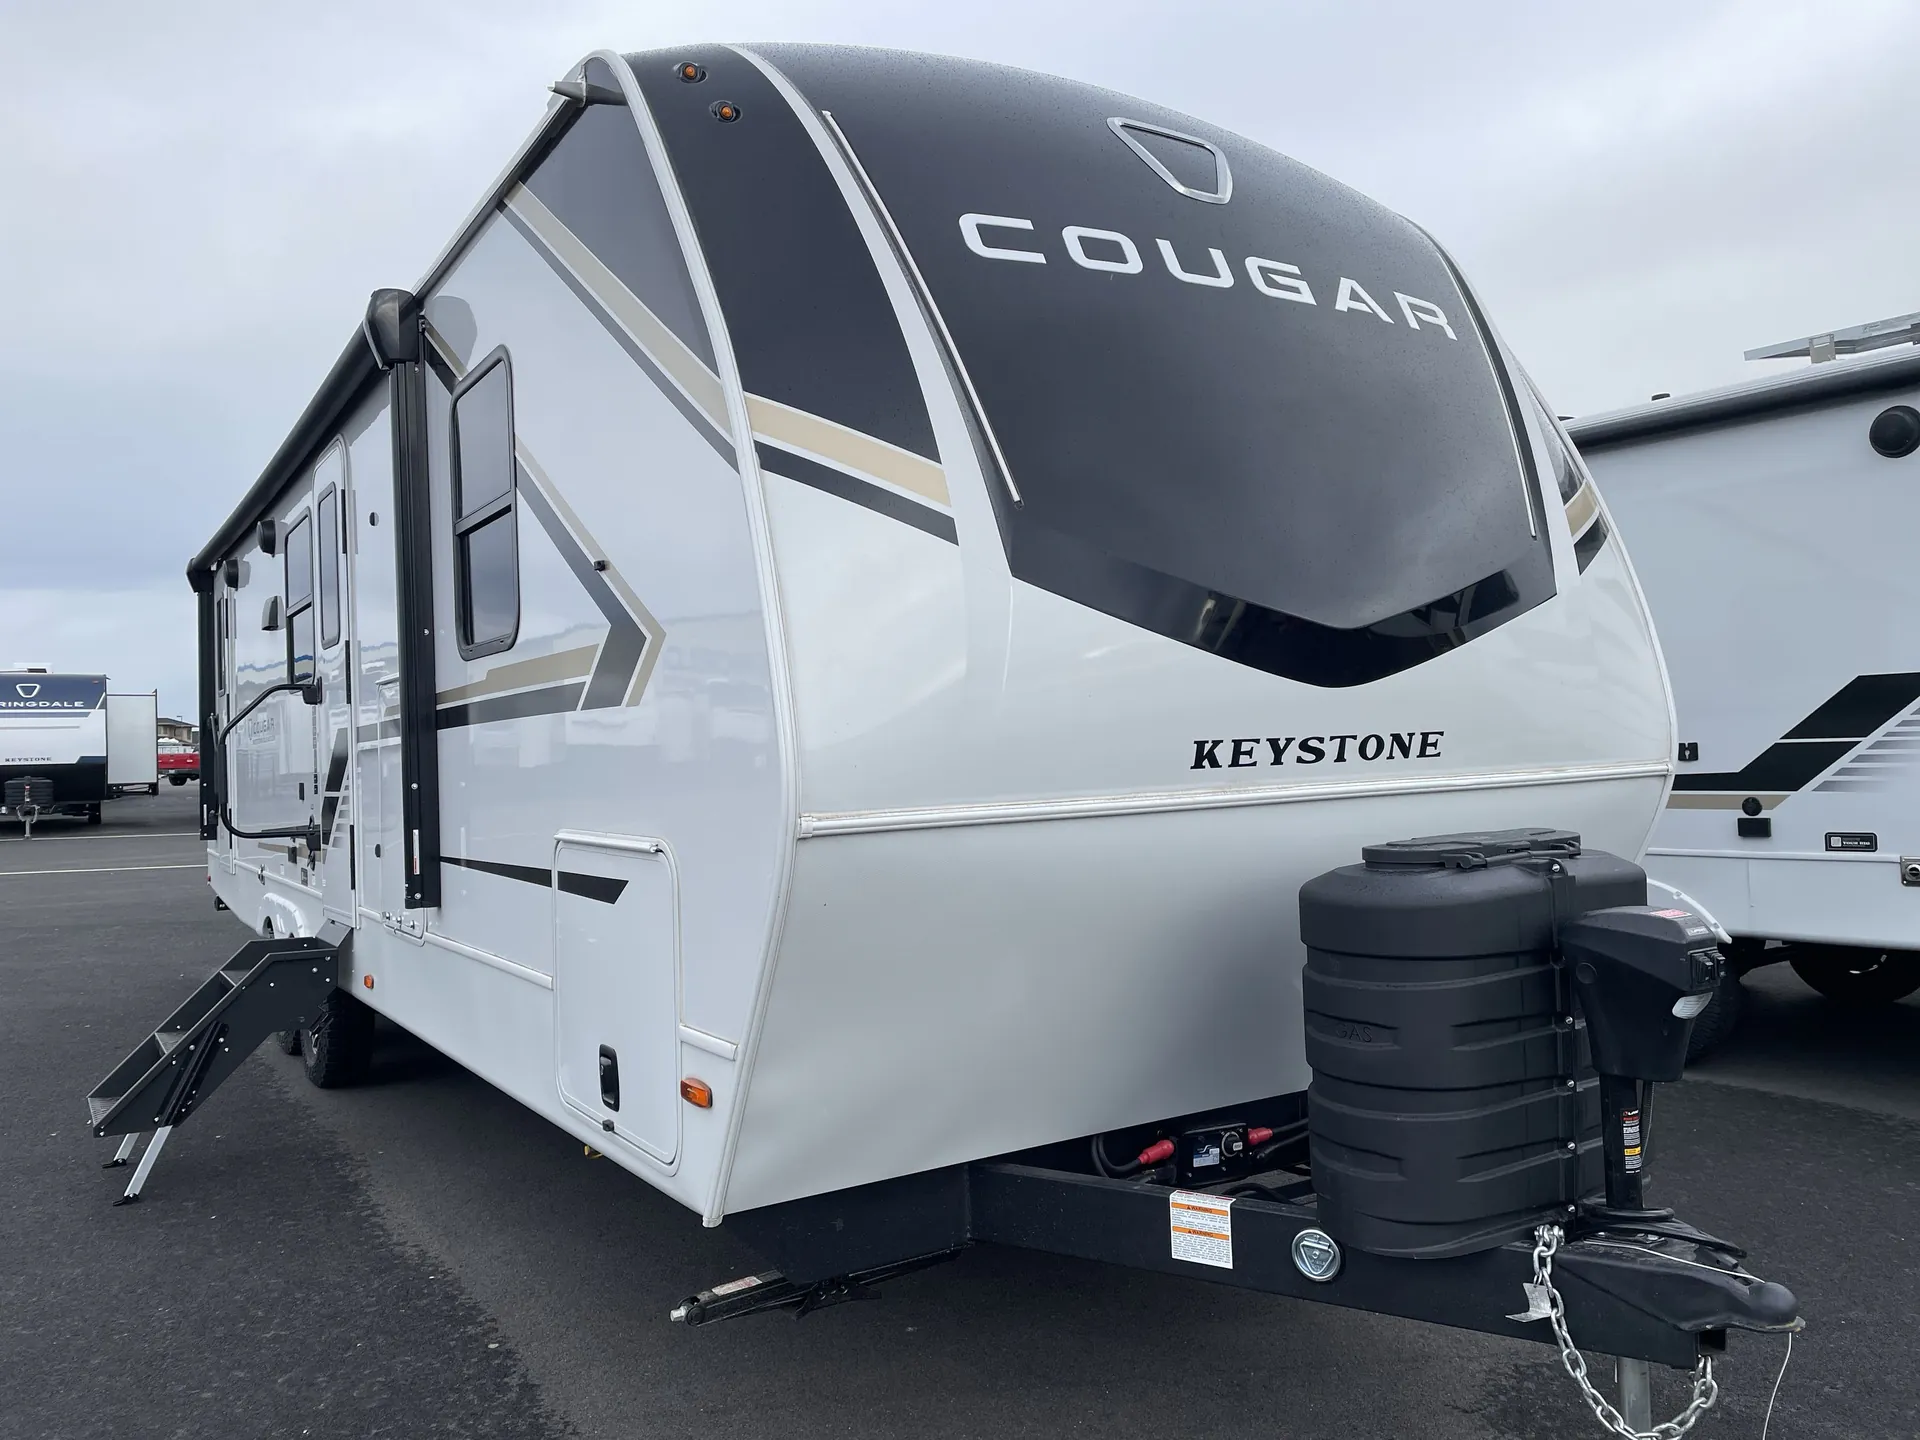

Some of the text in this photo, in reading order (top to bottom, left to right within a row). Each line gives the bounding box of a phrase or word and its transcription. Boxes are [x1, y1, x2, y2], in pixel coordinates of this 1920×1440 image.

[958, 212, 1458, 342] COUGAR
[1189, 730, 1445, 770] KEYSTONE
[1336, 1023, 1373, 1043] GAS
[1191, 1205, 1213, 1213] WARNING
[1191, 1229, 1214, 1237] WARNING
